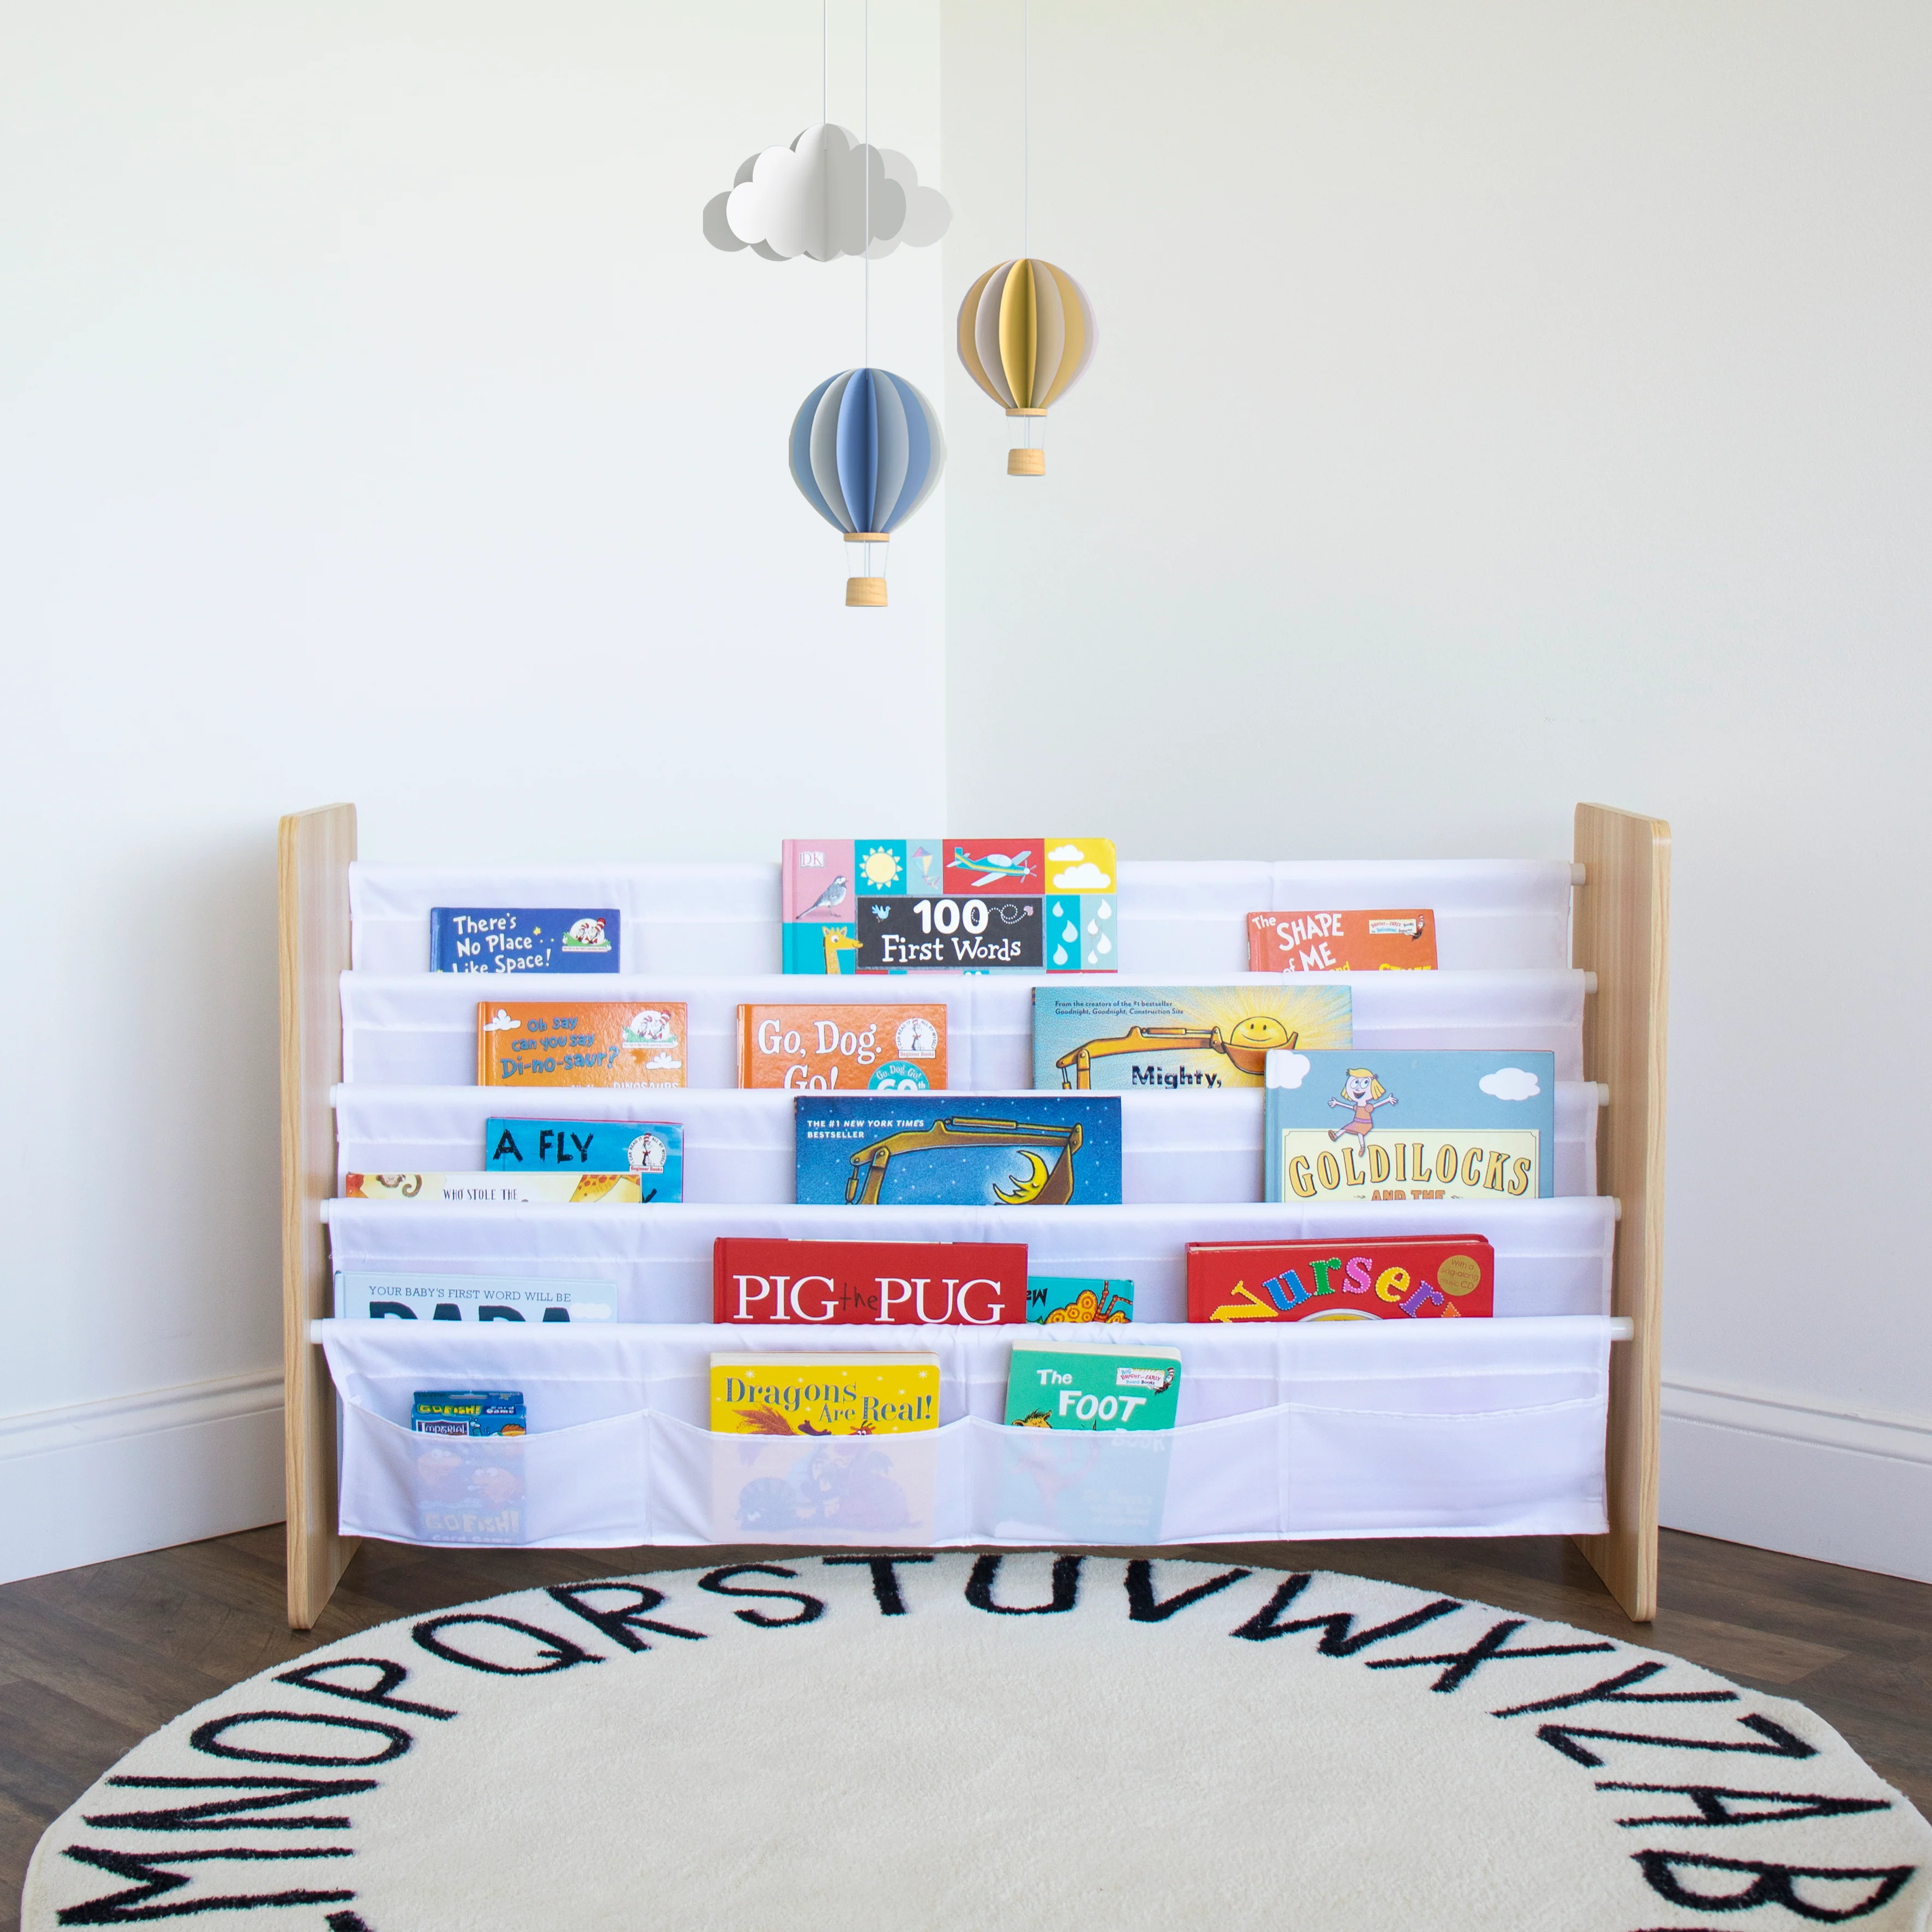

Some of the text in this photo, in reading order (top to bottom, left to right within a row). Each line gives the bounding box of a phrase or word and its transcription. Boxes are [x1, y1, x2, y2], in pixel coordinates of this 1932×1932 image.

[802, 853, 822, 866] DK
[453, 912, 517, 935] There's
[913, 899, 989, 935] 100
[1251, 914, 1277, 930] The
[1276, 913, 1344, 951] SHAPE
[457, 933, 533, 958] No Place
[882, 935, 1021, 962] First Words
[1298, 941, 1337, 972] ME
[452, 948, 551, 973] Like Space!
[527, 1016, 578, 1032] Oh say
[897, 1024, 906, 1035] READ
[511, 1033, 595, 1053] can you say
[758, 1019, 882, 1065] Go, Dog.
[500, 1045, 619, 1078] Di-no-saur?
[784, 1064, 839, 1089] Go!
[907, 1068, 922, 1081] Go!
[1132, 1065, 1222, 1089] Mighty,
[829, 1120, 840, 1128] #1
[493, 1128, 594, 1163] A FLY
[1289, 1142, 1531, 1198] GOLDILOCKS
[443, 1188, 518, 1201] WHO STOLE THE
[1371, 1190, 1406, 1201] AND
[1440, 1267, 1479, 1281] sing-along
[1451, 1259, 1467, 1268] With
[369, 1286, 571, 1302] YOUR BABY'S FIRST WORD WILL BE
[1209, 1257, 1462, 1324] Nurser
[1440, 1279, 1474, 1289] music CD
[732, 1274, 1005, 1324] PIG the PUG
[1037, 1369, 1072, 1385] The
[724, 1377, 857, 1411] Dragons
[1059, 1390, 1147, 1422] FOOT
[819, 1395, 932, 1423] Are Real!
